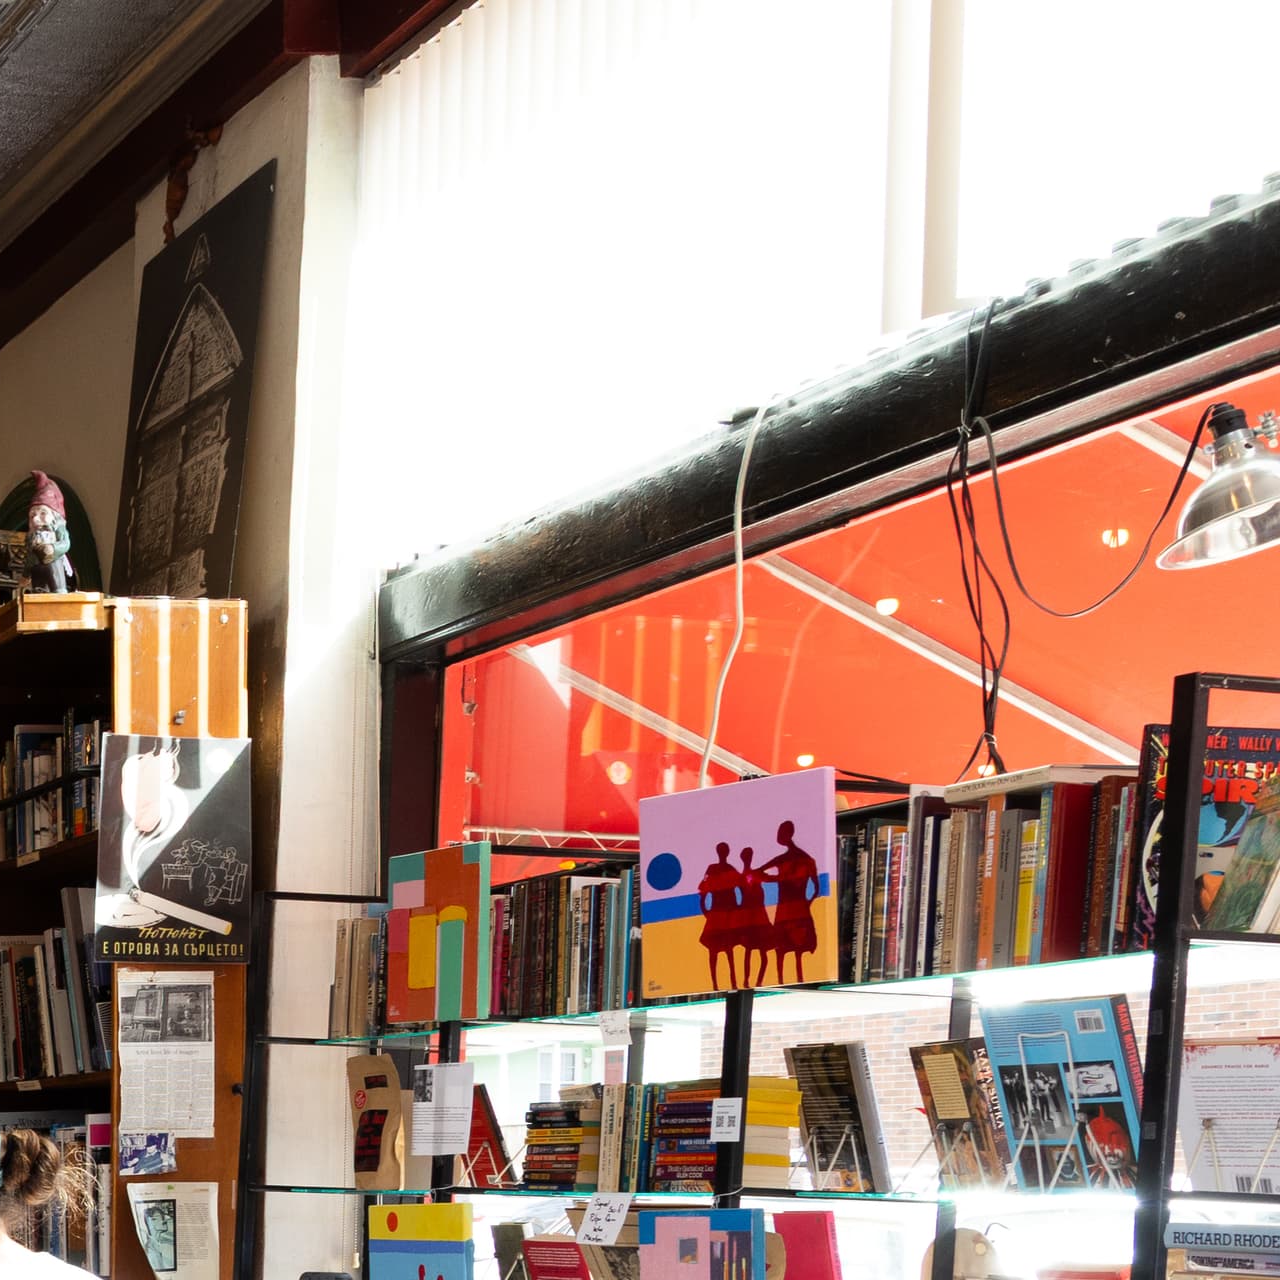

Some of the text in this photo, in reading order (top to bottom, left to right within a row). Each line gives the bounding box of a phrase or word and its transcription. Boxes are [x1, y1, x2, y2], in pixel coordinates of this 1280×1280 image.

[102, 941, 244, 957] Е ОТРОВА ЗА СЪРЦЕТО!
[1173, 1232, 1280, 1248] RICHARD RHODE
